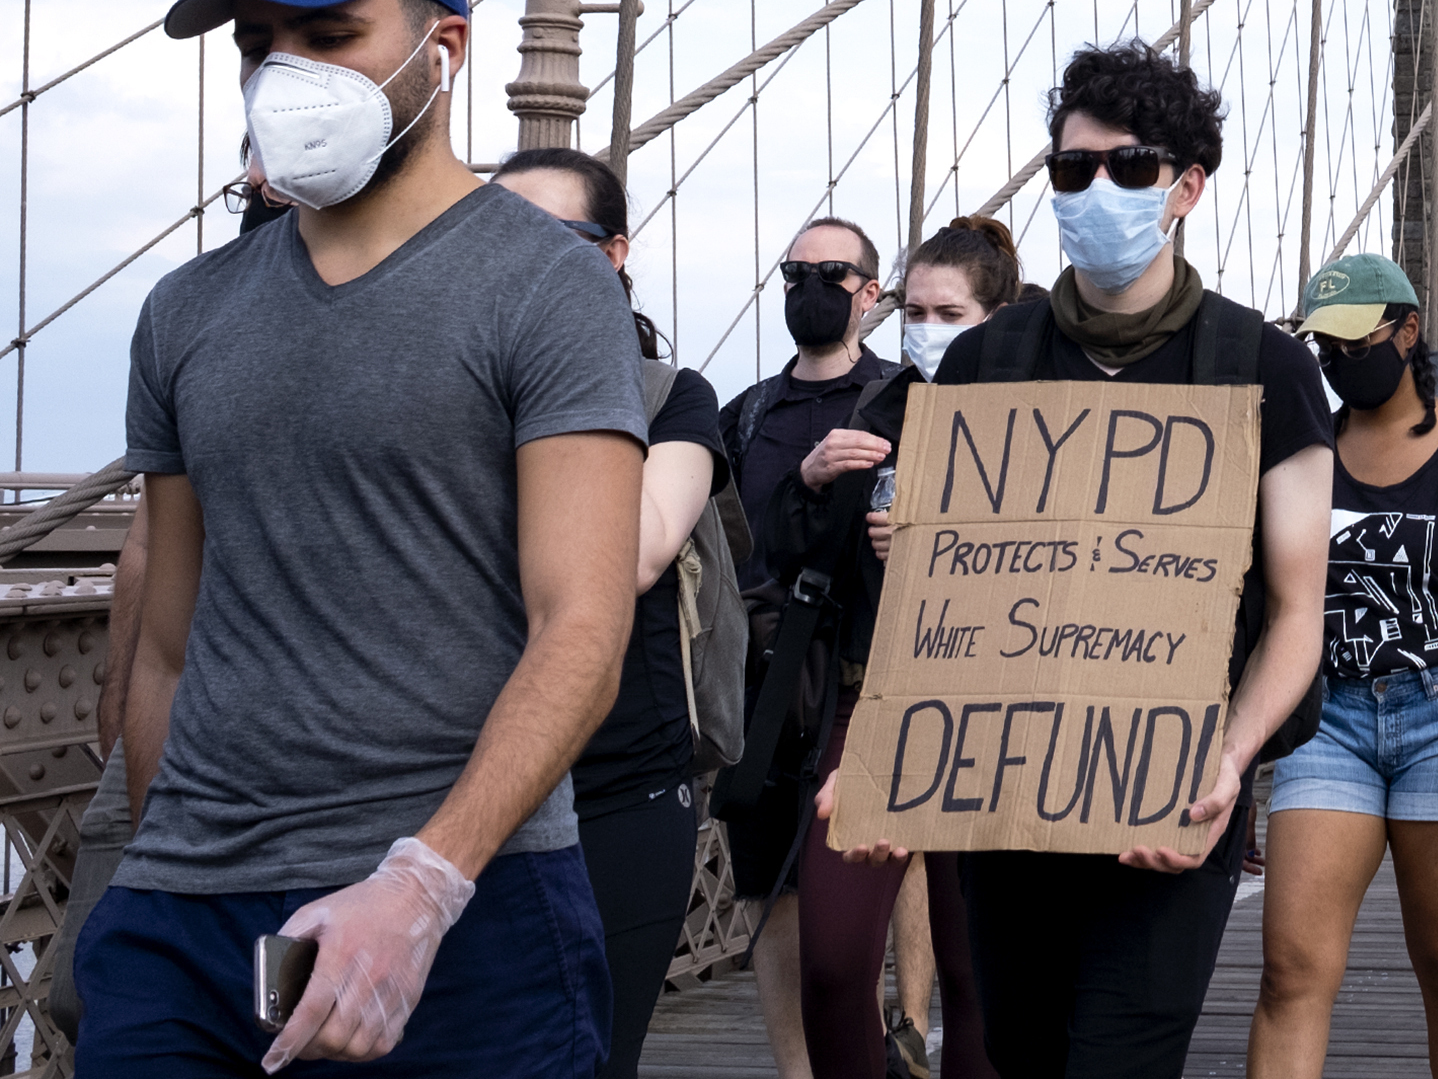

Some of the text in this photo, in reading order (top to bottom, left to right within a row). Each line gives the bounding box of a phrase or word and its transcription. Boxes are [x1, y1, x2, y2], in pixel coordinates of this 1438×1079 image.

[1319, 278, 1336, 293] FL
[940, 408, 1216, 516] NYPD
[928, 529, 1079, 578] PROTECTS
[1108, 529, 1218, 582] SERVES
[913, 597, 1186, 665] WHITE SUPREMACY
[886, 699, 1221, 828] DEFUND!
